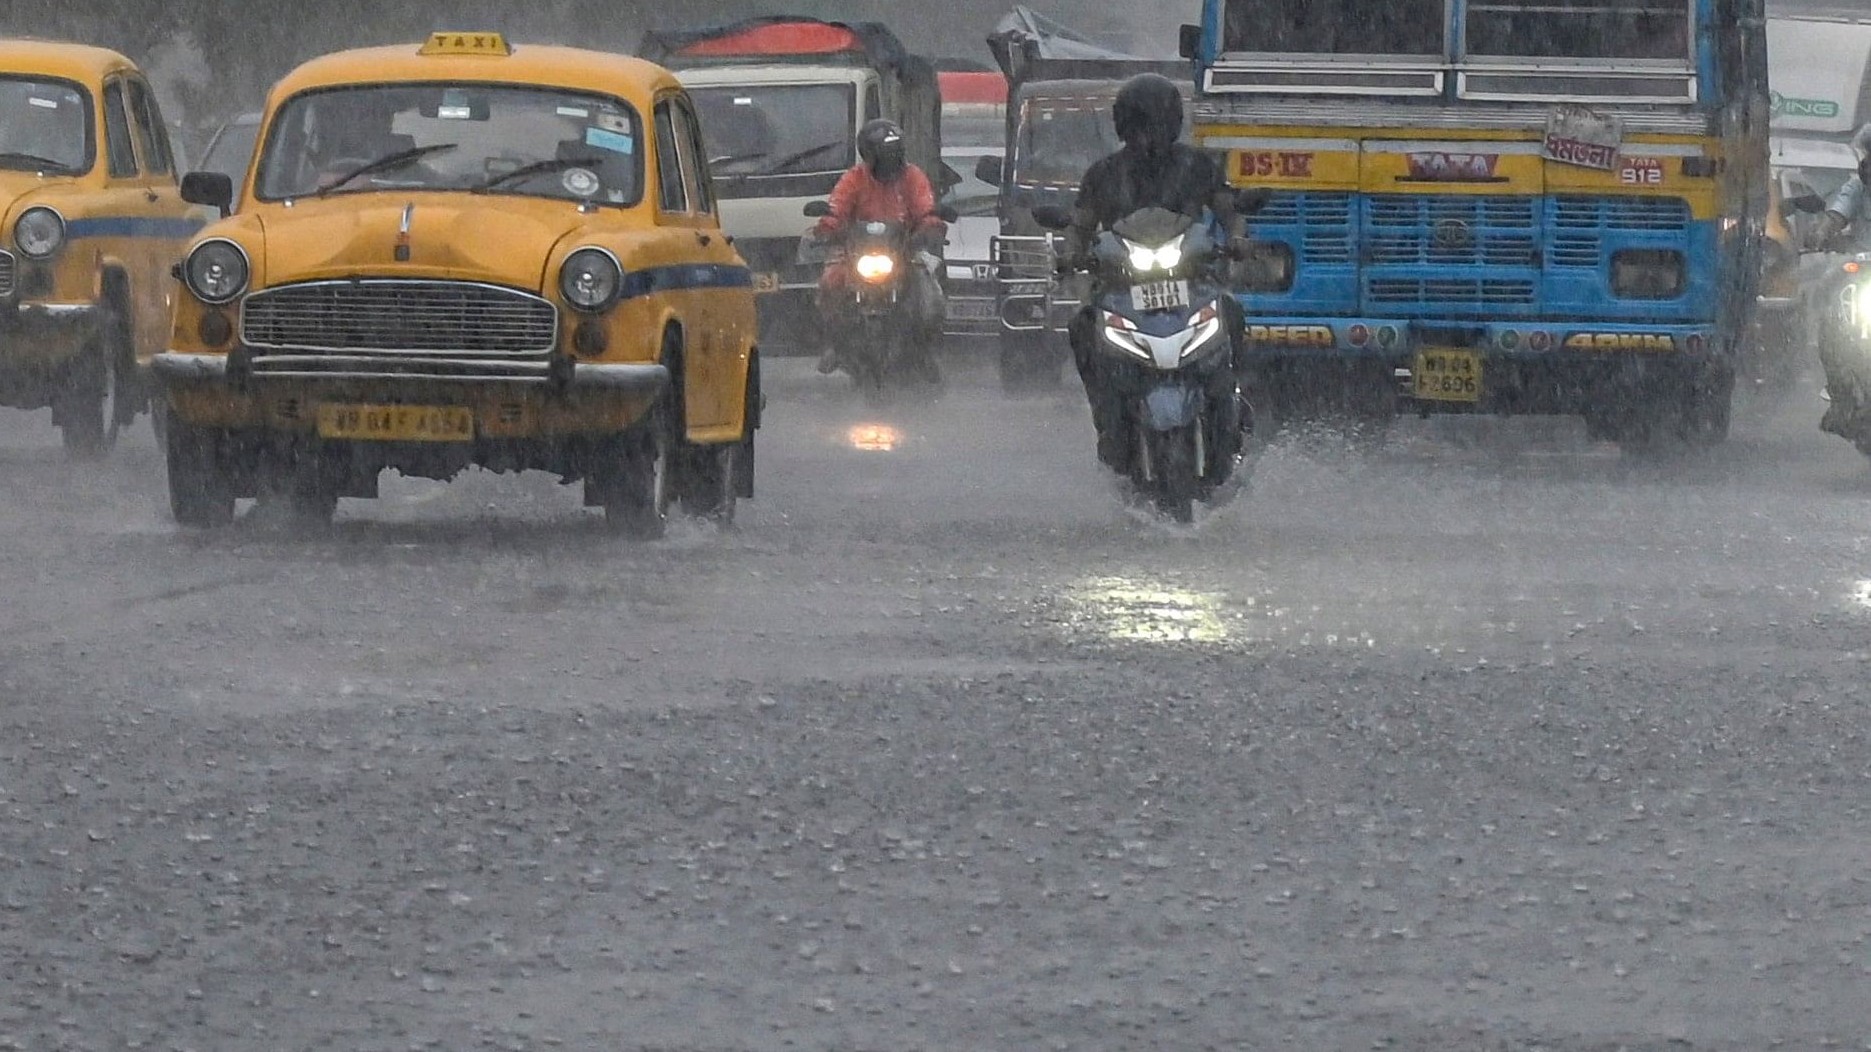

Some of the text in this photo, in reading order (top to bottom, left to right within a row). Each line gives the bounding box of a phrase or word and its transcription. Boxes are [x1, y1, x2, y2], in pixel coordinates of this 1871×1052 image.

[434, 35, 497, 48] TAXI
[1411, 153, 1489, 174] TATA
[1629, 157, 1658, 167] TATA
[1621, 167, 1662, 184] 912
